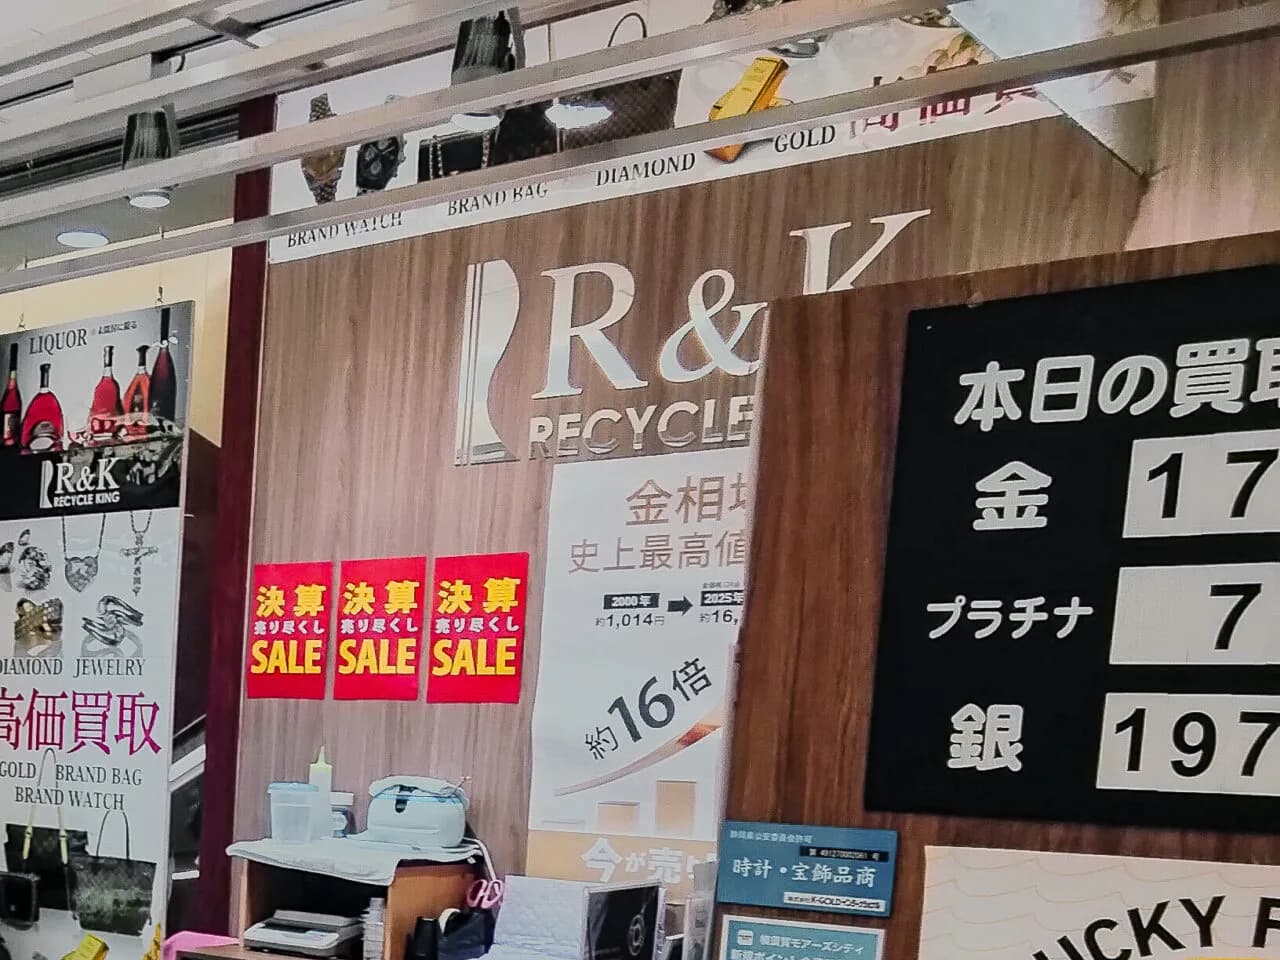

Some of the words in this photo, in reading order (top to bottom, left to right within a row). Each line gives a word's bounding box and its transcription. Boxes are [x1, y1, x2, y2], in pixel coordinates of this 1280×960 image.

[773, 124, 836, 153] GOLD
[595, 152, 696, 187] DIAMOND
[447, 190, 506, 216] BRAND
[512, 182, 549, 204] BAG
[287, 223, 339, 248] BRAND
[344, 212, 403, 237] WATCH
[29, 328, 88, 355] LIQUOR
[529, 395, 754, 459] RECYCLE
[54, 457, 122, 494] R&K
[53, 493, 93, 507] RECYCLE
[95, 491, 121, 505] KING
[972, 461, 1052, 531] 金
[568, 531, 745, 574] 史上最高値
[256, 584, 326, 617] 決算
[342, 580, 420, 615] 決算
[437, 577, 521, 614] 決算
[253, 619, 325, 635] 売り尽くし
[340, 617, 418, 634] 売り尽くし
[435, 616, 520, 635] 売り尽くし
[926, 595, 1094, 639] プラチナ
[1210, 583, 1263, 650] 7
[73, 658, 146, 678] JEWELRY
[250, 639, 322, 674] SALE
[338, 638, 417, 674] SALE
[432, 638, 517, 676] SALE
[584, 656, 713, 761] 約16倍
[947, 703, 1025, 772] 銀
[1114, 707, 1280, 777] 197
[56, 764, 107, 784] BRAND
[111, 767, 142, 786] BAG
[15, 786, 64, 806] BRAND
[68, 790, 124, 811] WATCH
[732, 857, 877, 888] 時計・宝飾品商
